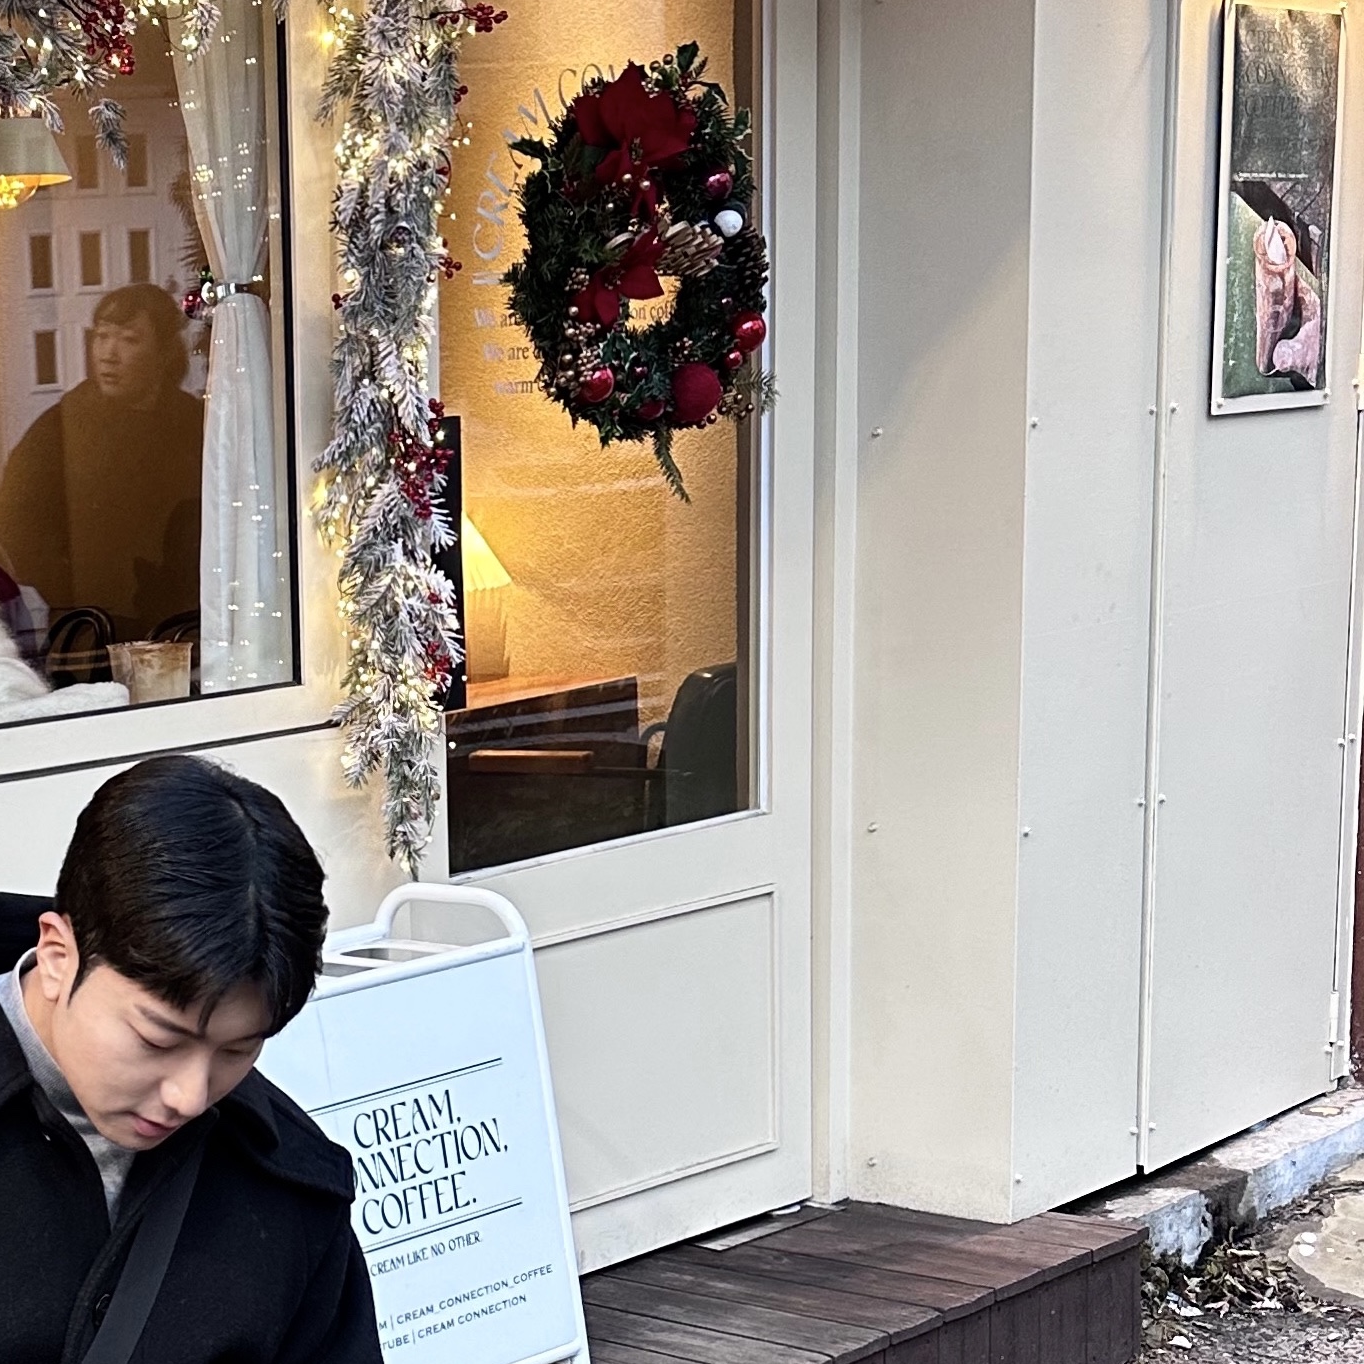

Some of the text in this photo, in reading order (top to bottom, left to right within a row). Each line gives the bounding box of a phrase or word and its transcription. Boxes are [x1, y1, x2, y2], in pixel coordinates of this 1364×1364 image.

[508, 346, 530, 360] are
[353, 1089, 461, 1149] CREAM,
[353, 1118, 508, 1194] NNECTION,
[362, 1171, 477, 1235] COFFEE.
[370, 1255, 405, 1277] CREAM
[406, 1247, 429, 1266] LIKE
[430, 1242, 446, 1257] NO
[382, 1334, 411, 1351] TUBE
[417, 1318, 456, 1340] CREAM
[457, 1293, 528, 1325] CONNECTION
